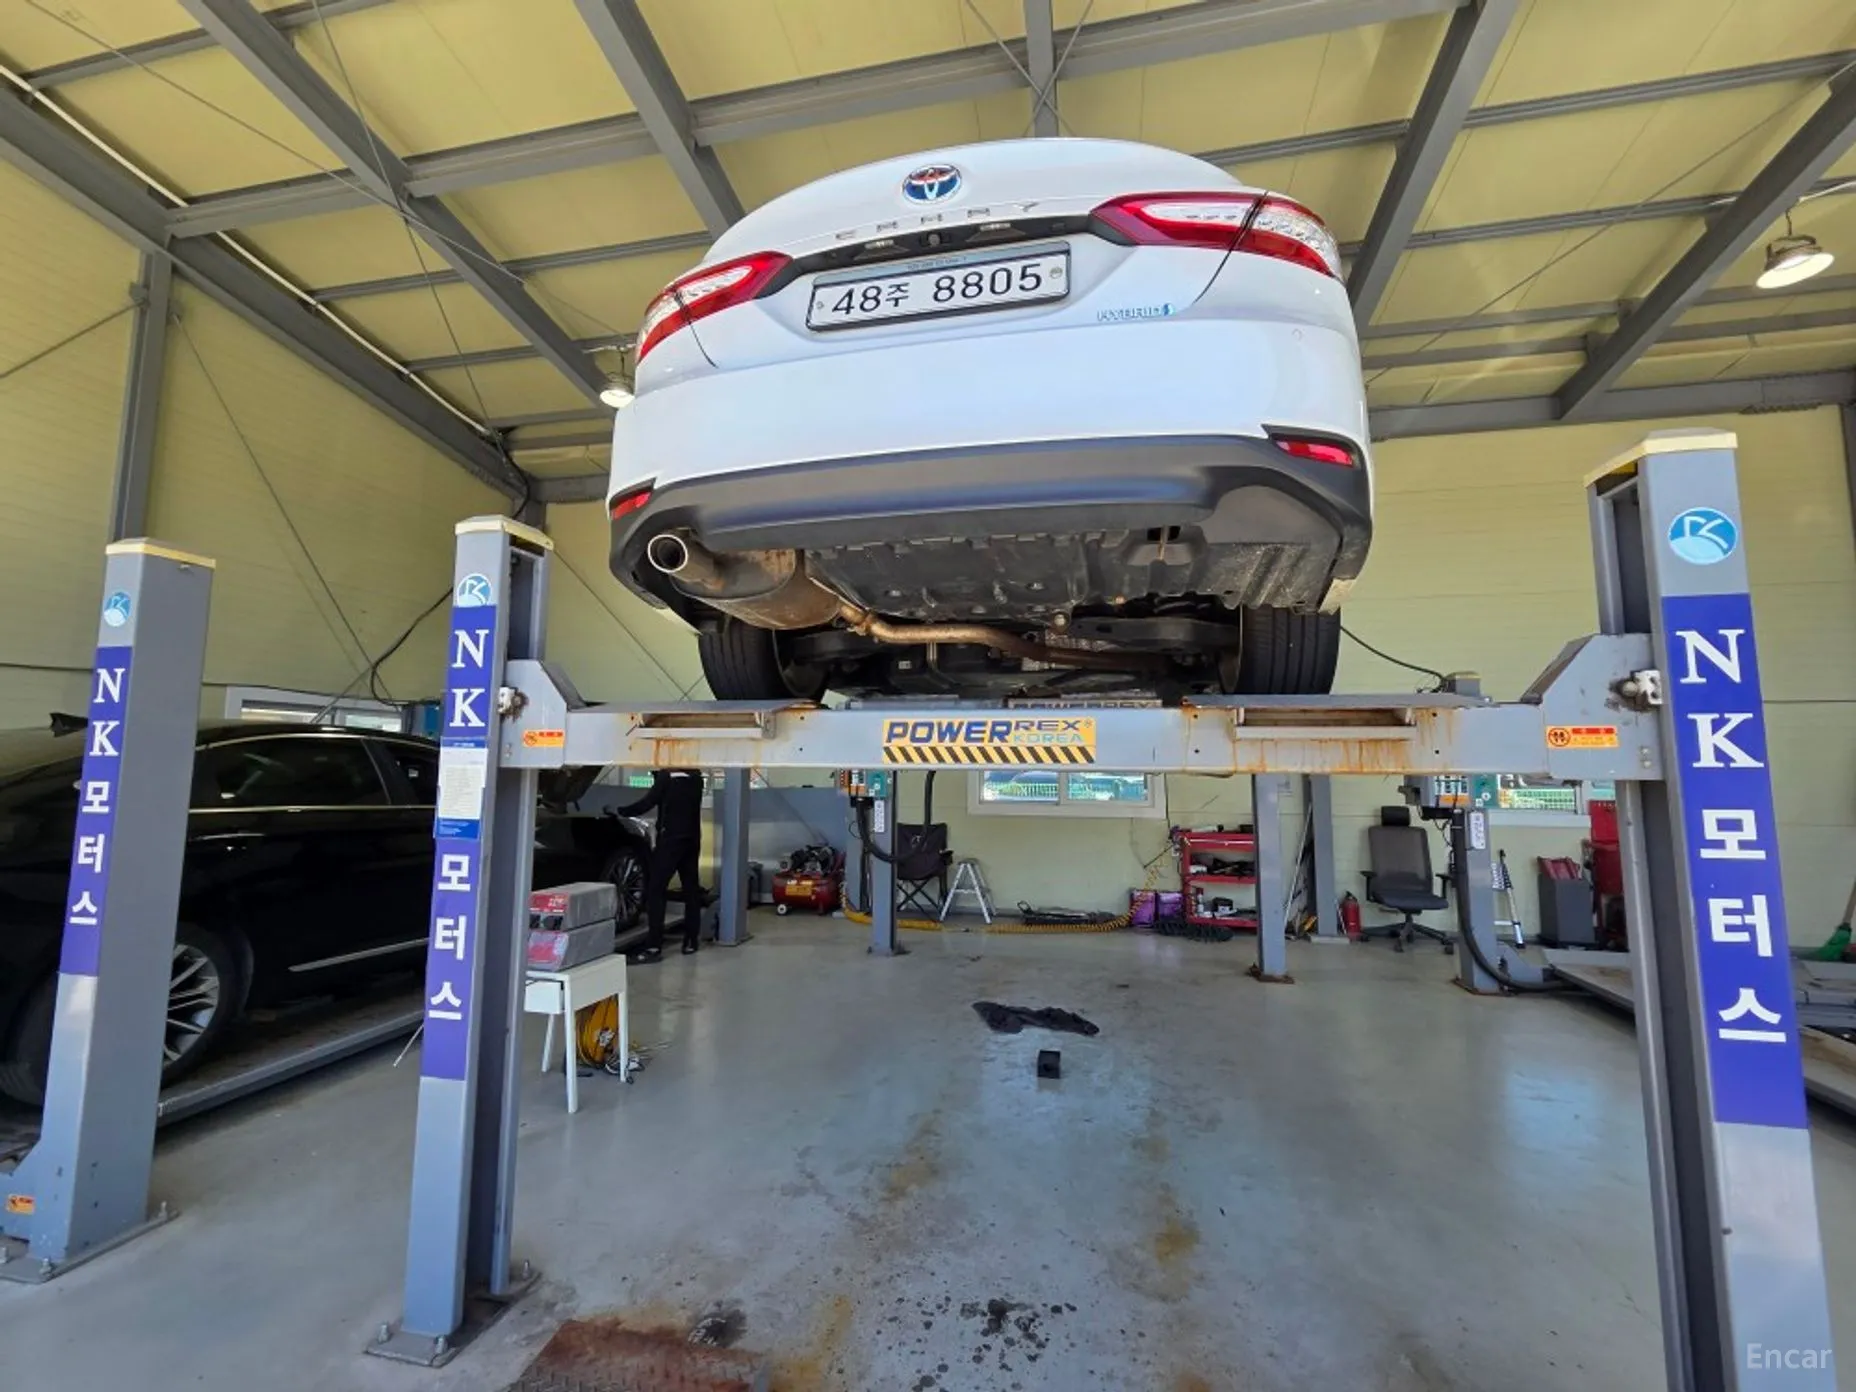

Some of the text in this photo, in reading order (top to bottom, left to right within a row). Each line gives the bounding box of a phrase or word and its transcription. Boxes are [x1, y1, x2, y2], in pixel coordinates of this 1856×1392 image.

[832, 263, 1042, 315] 48주 8805
[1013, 733, 1084, 744] KOREA
